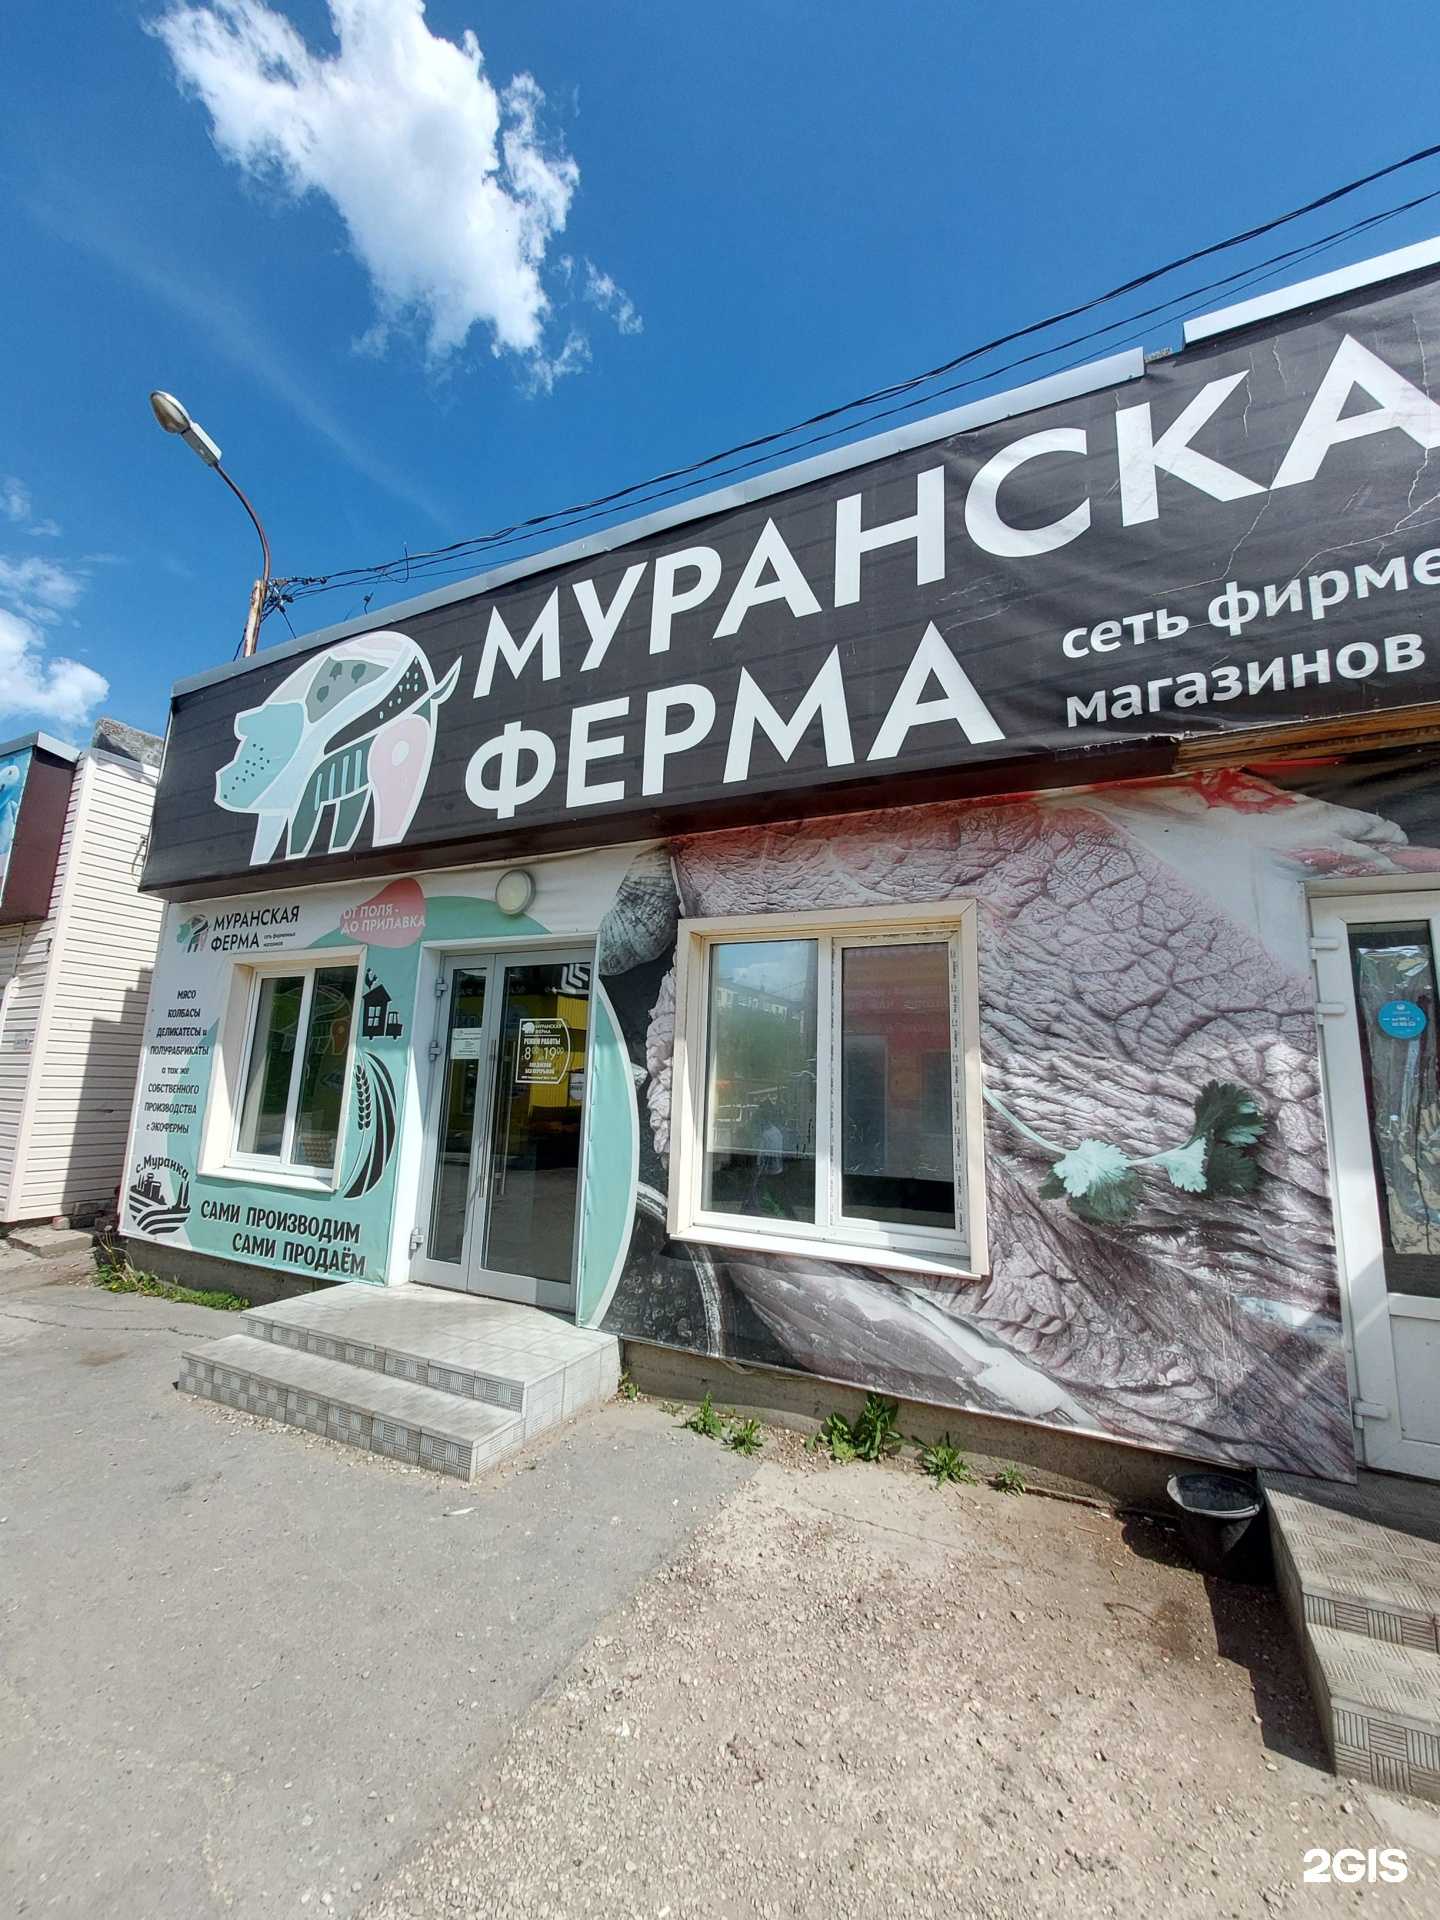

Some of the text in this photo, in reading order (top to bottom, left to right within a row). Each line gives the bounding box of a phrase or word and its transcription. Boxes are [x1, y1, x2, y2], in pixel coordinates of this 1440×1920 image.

[474, 333, 1440, 699] МУРАНСКА
[1063, 548, 1440, 658] сеть фирме
[1066, 633, 1426, 728] магазинов
[466, 621, 1006, 819] ФЕРМА
[213, 905, 300, 931] МУРАНСКАЯ
[343, 907, 357, 920] ОТ
[360, 904, 393, 918] ПОЛЯ
[340, 914, 426, 935] ДО ПРИЛАВКА
[211, 932, 260, 951] ФЕРМА
[177, 990, 197, 999] МЯСО
[167, 1008, 201, 1018] КОЛБАСЫ
[156, 1026, 202, 1037] ДЕЛИКАТЕСЫ
[150, 1045, 209, 1055] ПОЛУФАБРИКАТЫ
[148, 1083, 200, 1094] СОБСТВЕННОГО
[144, 1102, 197, 1114] ПРОИЗВОДСТВА
[150, 1121, 190, 1134] ЭКОФЕРМЫ
[200, 1200, 361, 1244] САМИ ПРОИЗВОДИМ
[232, 1233, 366, 1276] САМИ ПРОДАЁМ
